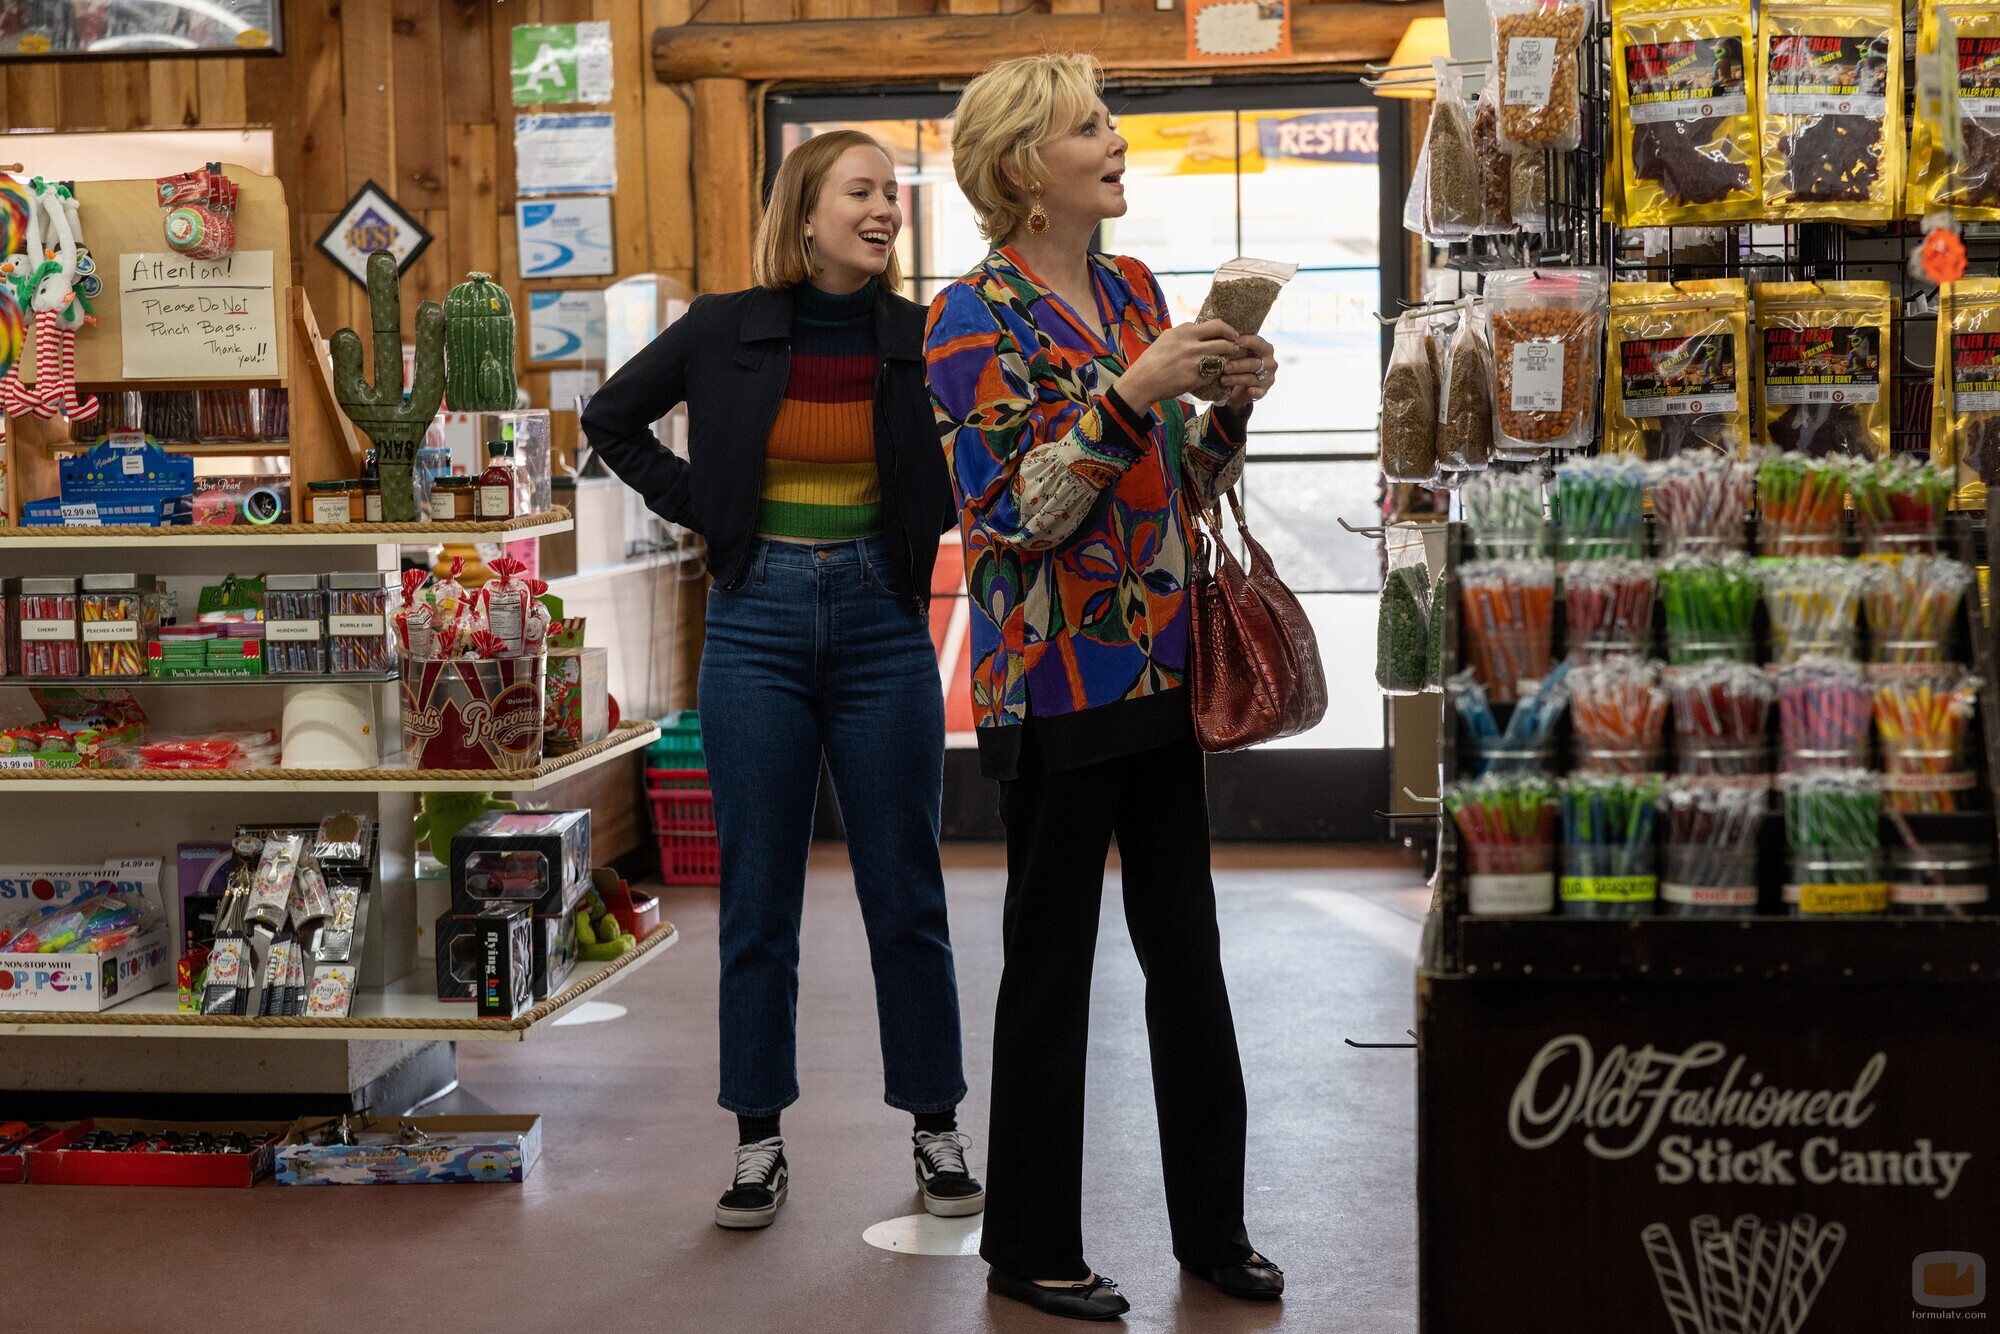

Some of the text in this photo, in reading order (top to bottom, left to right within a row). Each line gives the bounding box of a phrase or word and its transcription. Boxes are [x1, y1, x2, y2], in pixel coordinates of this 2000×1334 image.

[526, 43, 567, 87] A
[1630, 87, 1714, 105] SRIRACHA BEEF JERKY
[1826, 85, 1841, 95] BEEF
[1981, 87, 1994, 97] HOT
[142, 295, 248, 315] Please Do Not
[146, 322, 190, 337] Punch
[1768, 328, 1834, 343] ALIEN FRESH
[204, 340, 242, 355] Thank
[1766, 375, 1852, 385] ROADKILL ORIGINAL BEEF JERKY
[196, 479, 216, 491] Love
[217, 477, 242, 493] Pearl
[62, 508, 85, 517] $2.99
[120, 861, 142, 869] $4.99
[4, 961, 71, 969] NON-STOP WITH
[485, 931, 499, 1007] flying ball
[0, 970, 29, 991] OP
[1508, 1033, 1888, 1160] Old Fashioned
[1655, 1135, 1972, 1199] Stick Candy
